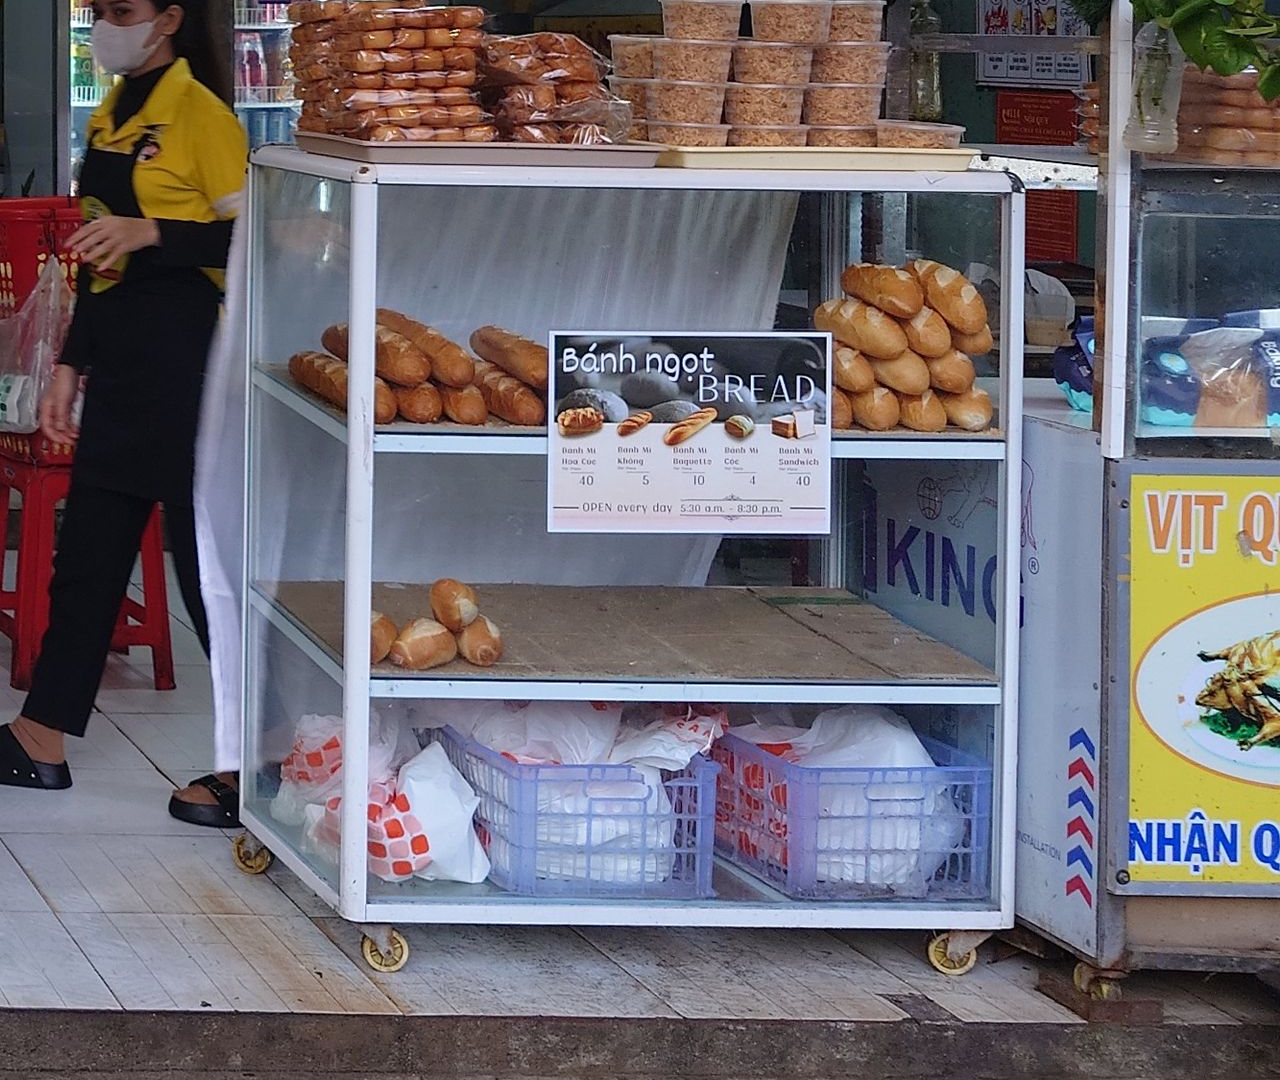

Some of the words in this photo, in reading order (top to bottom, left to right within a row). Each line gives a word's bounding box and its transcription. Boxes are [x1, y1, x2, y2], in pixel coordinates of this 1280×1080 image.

[562, 341, 636, 373] Bánh
[645, 346, 715, 383] ngọt
[698, 374, 816, 403] BREAD
[778, 457, 820, 466] Sandwich
[579, 475, 594, 486] 40
[642, 475, 650, 486] 5
[692, 475, 705, 486] 10
[748, 475, 756, 486] 4
[795, 476, 811, 487] 40
[582, 503, 612, 513] OPEN
[617, 503, 648, 515] every
[652, 503, 673, 514] day
[736, 504, 758, 514] 8:30
[761, 505, 782, 516] p.m.
[1145, 492, 1226, 566] VỊT
[1128, 810, 1238, 873] NHẬN
